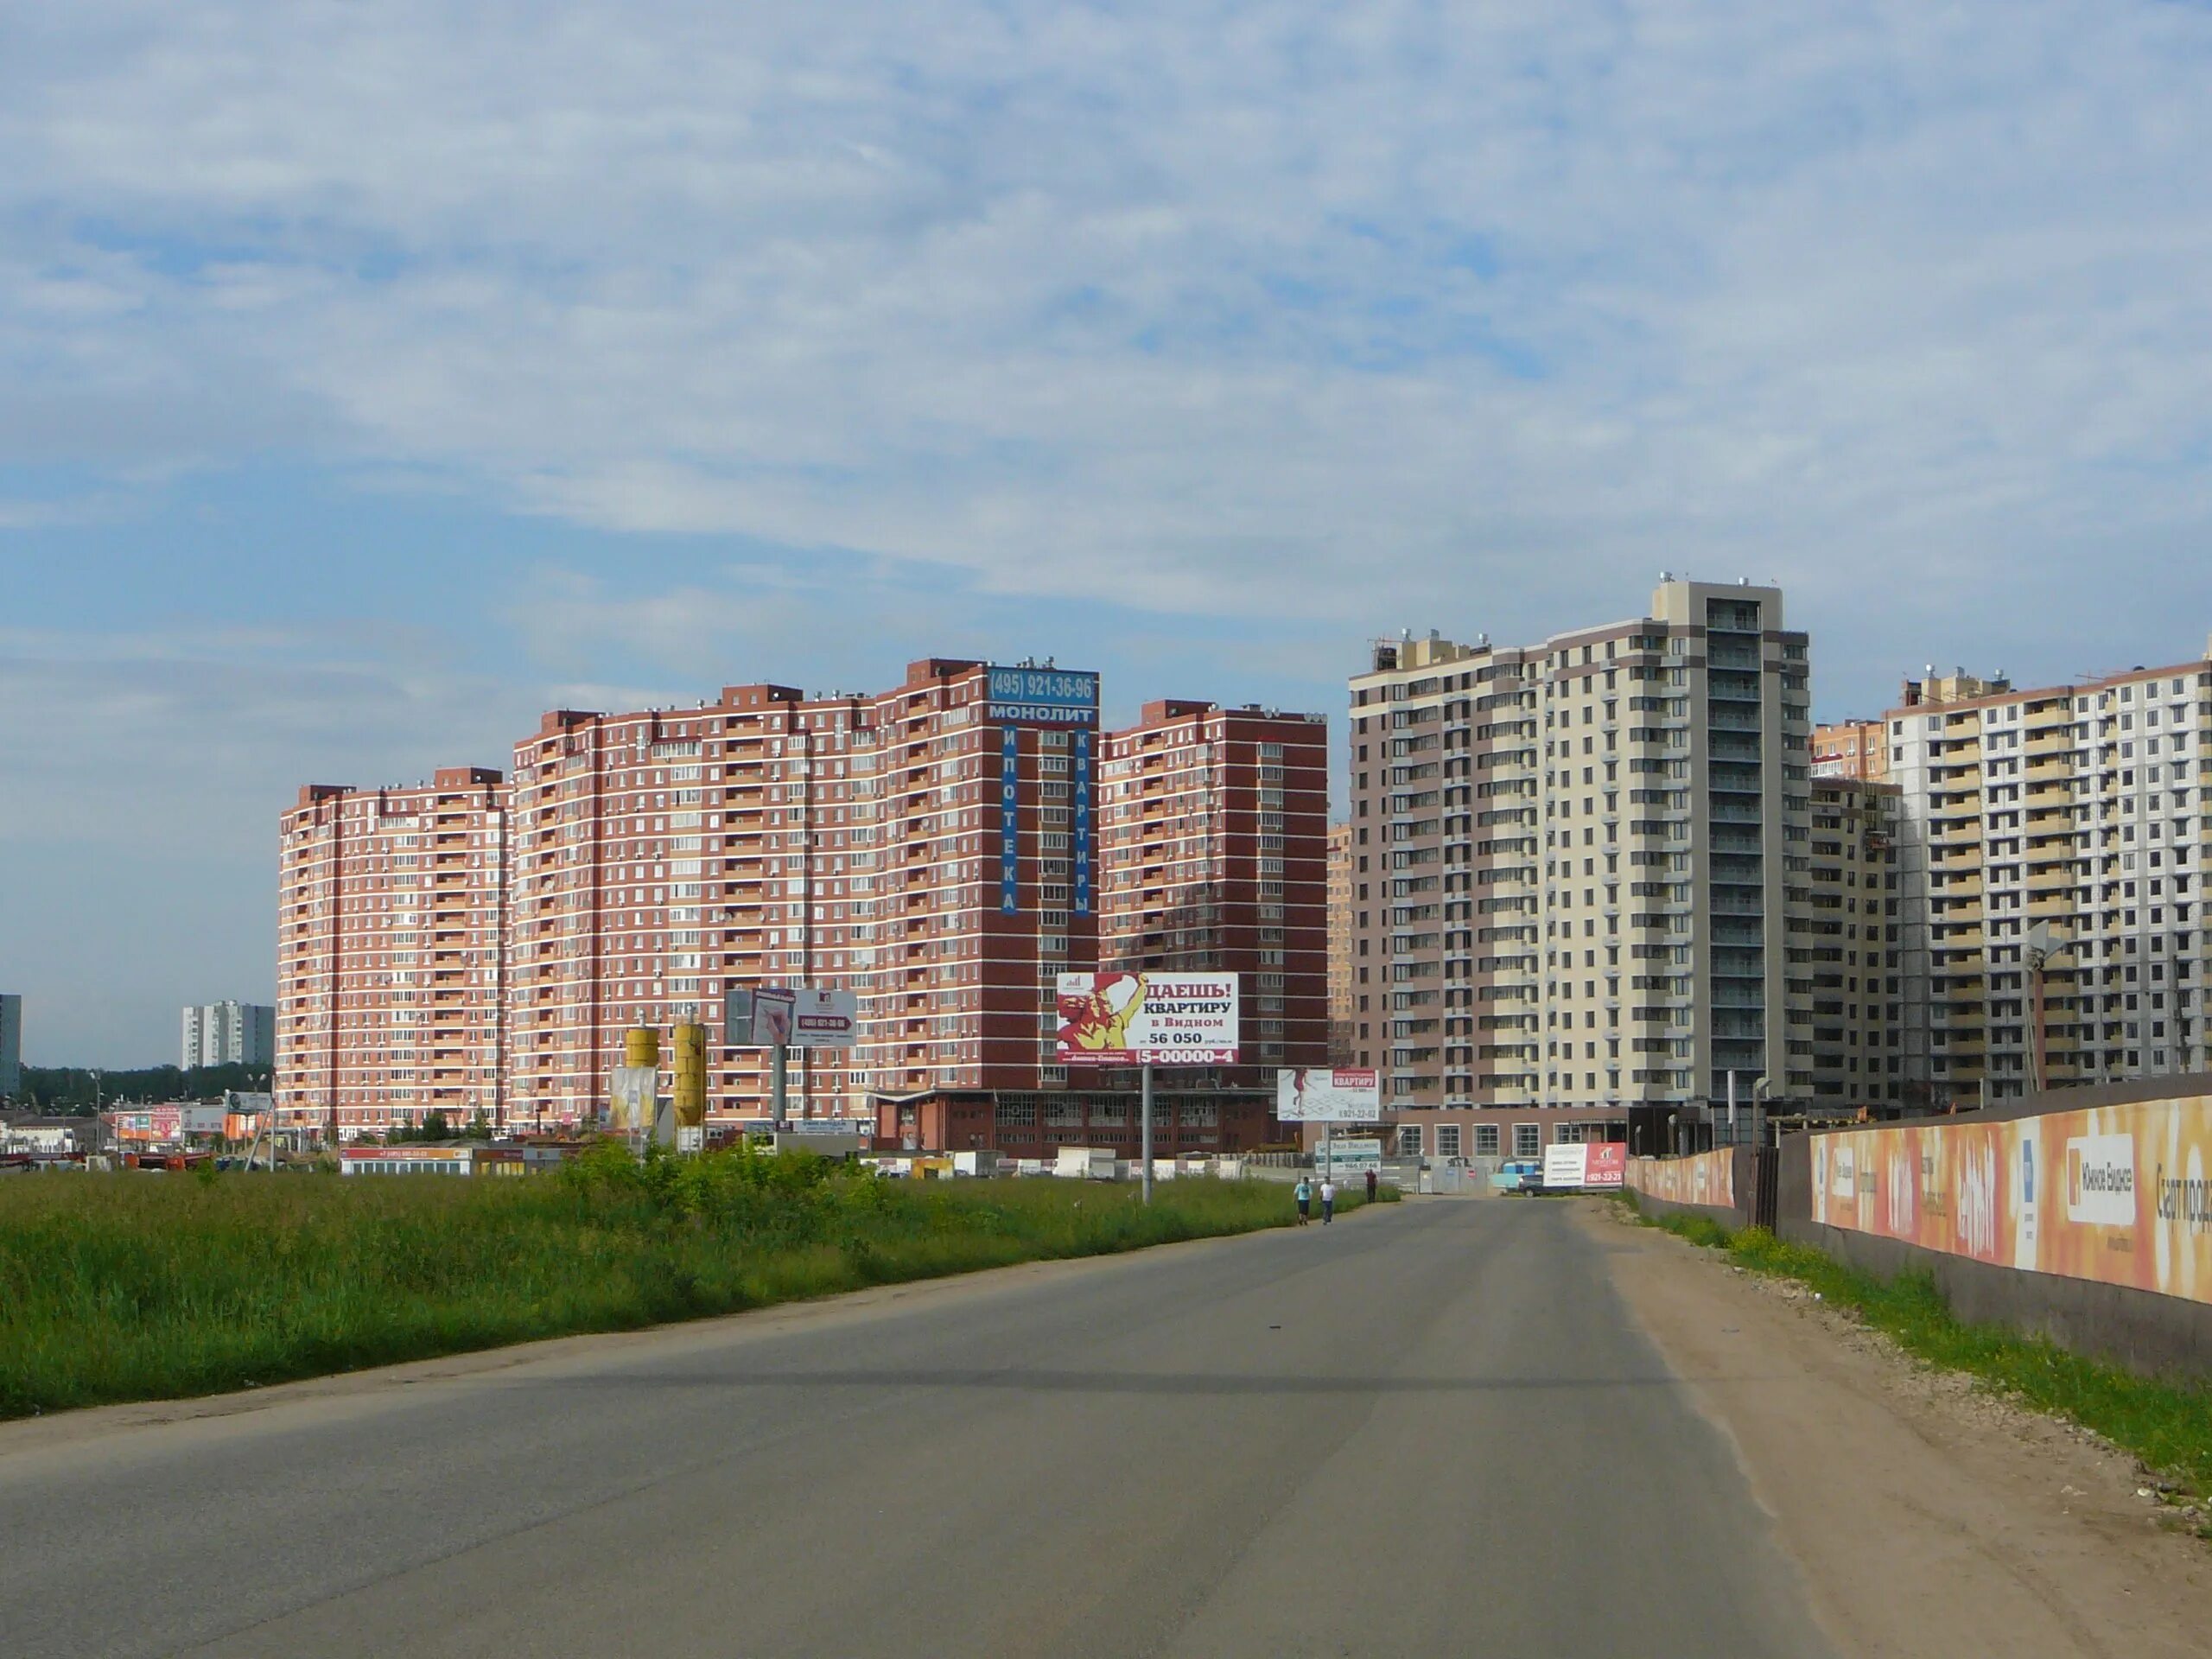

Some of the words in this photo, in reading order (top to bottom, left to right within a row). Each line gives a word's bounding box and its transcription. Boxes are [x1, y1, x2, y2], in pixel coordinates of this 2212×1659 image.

[990, 671, 1025, 701] (495)
[1027, 674, 1092, 699] 921-36-96
[988, 704, 1093, 723] МОНОЛИТ
[1003, 729, 1016, 910] ИПОТЕКА
[1075, 733, 1089, 912] КВАРТИРЫ
[1144, 983, 1231, 1001] ДАЕШЬ!
[1144, 1002, 1232, 1014] КВАРТИРУ
[1165, 1017, 1224, 1029] Видном
[1149, 1033, 1168, 1044] 56
[1173, 1033, 1202, 1044] 050
[1334, 1077, 1374, 1086] КВАРТИРУ
[2082, 1161, 2106, 1192] Южное
[2106, 1161, 2133, 1196] Видное
[2156, 1162, 2182, 1236] Старт
